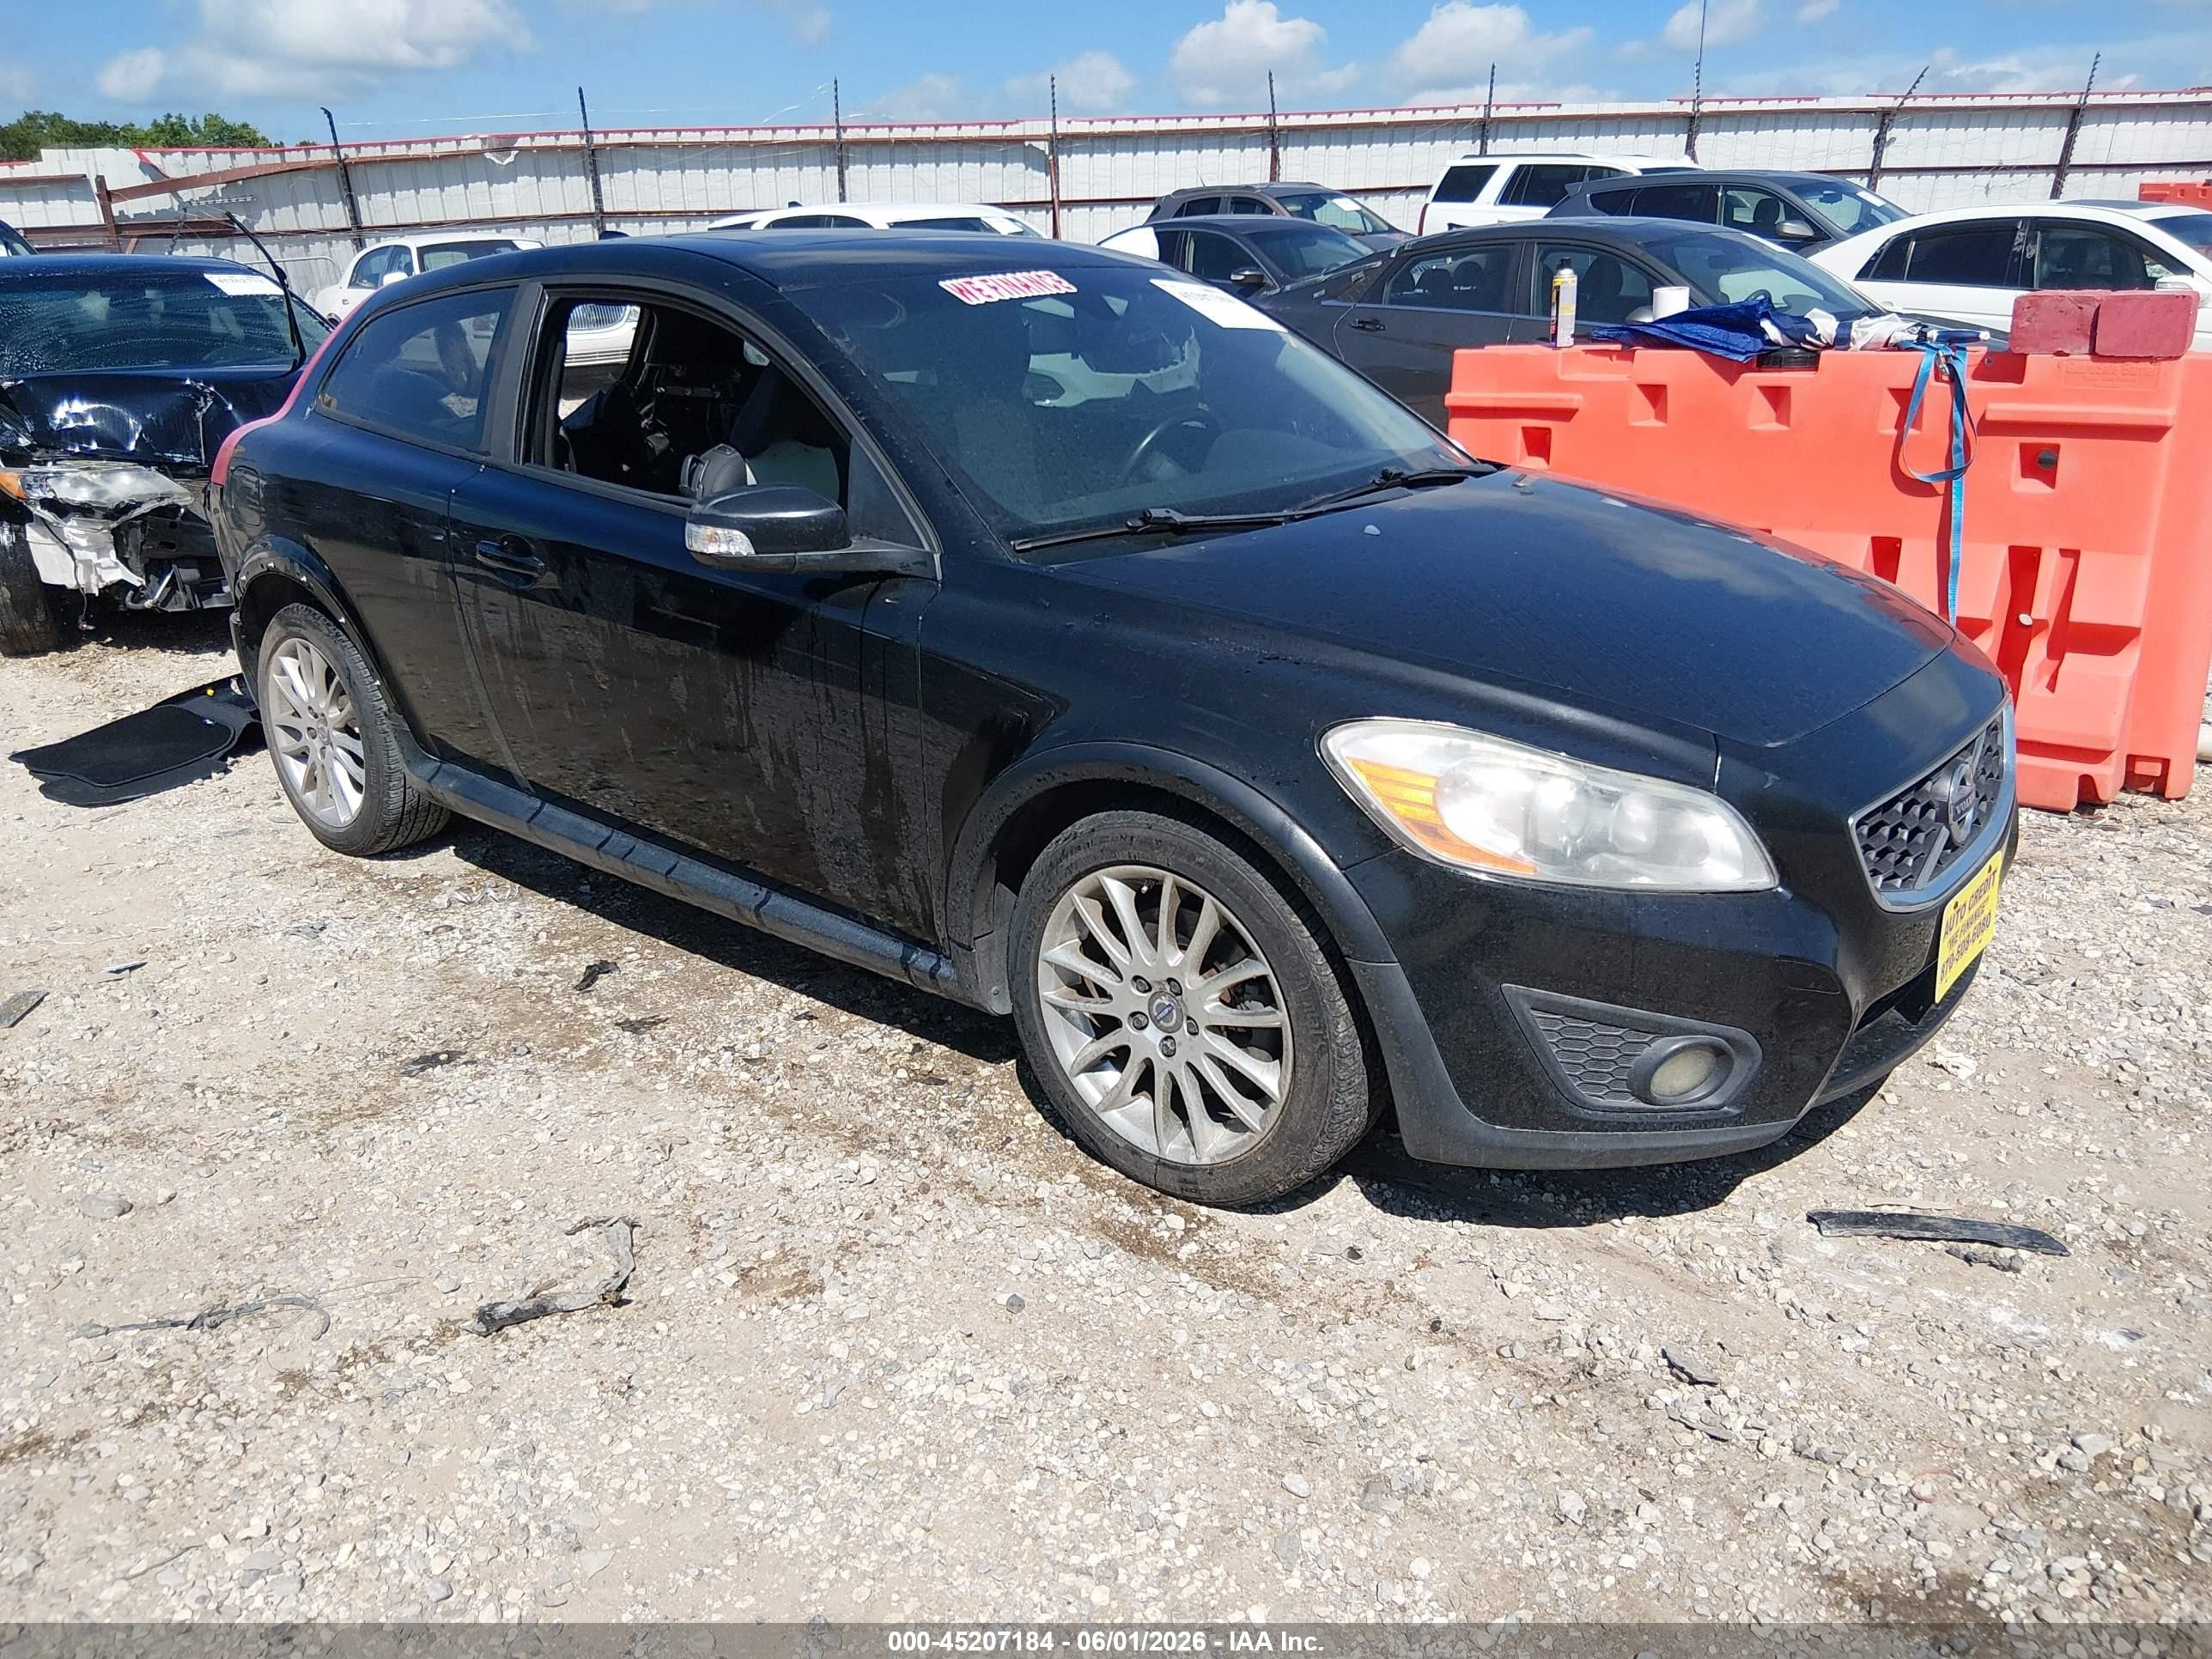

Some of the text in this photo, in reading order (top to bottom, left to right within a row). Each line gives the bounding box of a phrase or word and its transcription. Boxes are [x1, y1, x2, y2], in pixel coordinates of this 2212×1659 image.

[940, 273, 1073, 303] WE FINANCE
[1944, 870, 1997, 936] AUTO CREDIT
[1940, 911, 1991, 982] 870-508-6080
